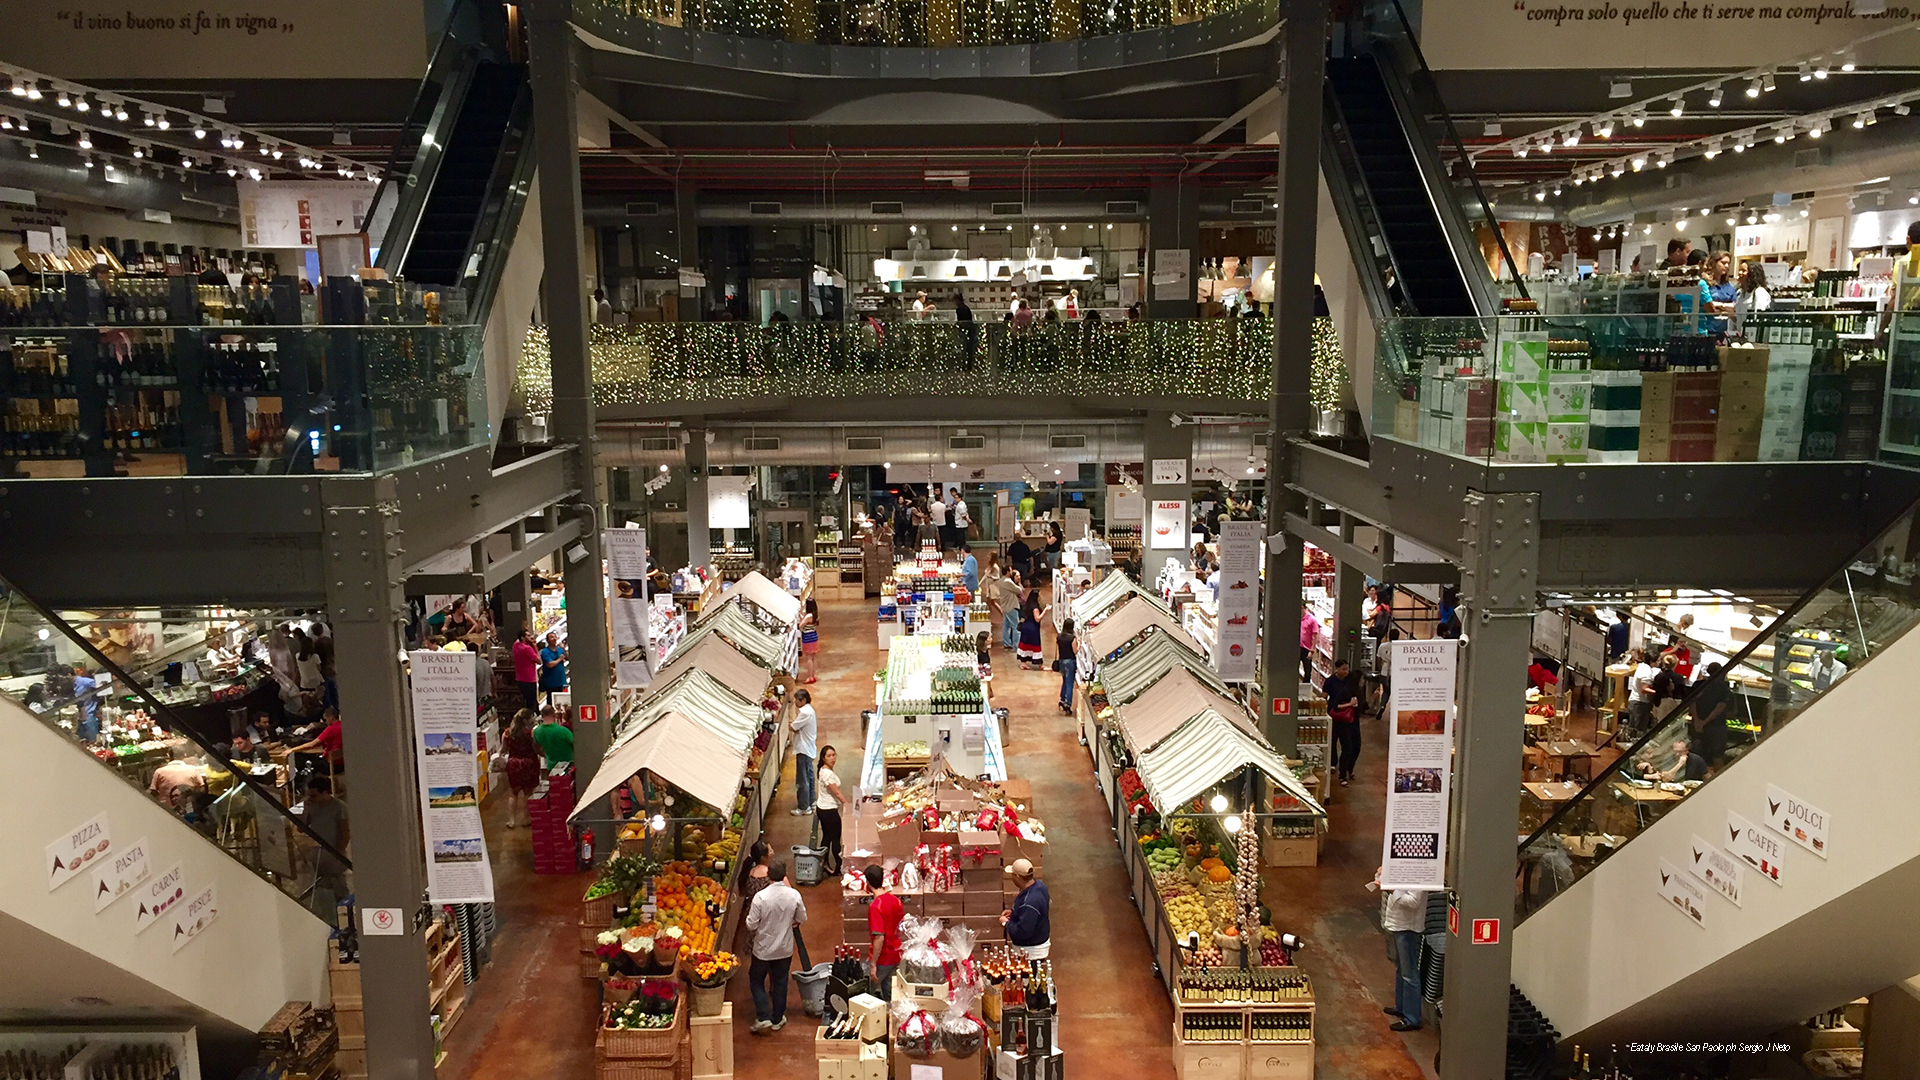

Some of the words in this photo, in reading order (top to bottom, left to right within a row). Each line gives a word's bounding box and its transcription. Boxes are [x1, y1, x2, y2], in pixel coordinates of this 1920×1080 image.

[88, 14, 122, 30] vino
[126, 11, 175, 30] buono
[179, 13, 191, 30] si
[192, 10, 211, 35] fa
[216, 13, 231, 30] in
[1587, 2, 1618, 20] solo
[1622, 1, 1669, 26] quello
[1673, 1, 1698, 20] che
[1702, 3, 1714, 20] ti
[1716, 6, 1755, 20] serve
[1759, 6, 1782, 20] ma
[420, 654, 456, 663] BRASIL
[458, 655, 465, 663] E
[1402, 645, 1438, 654] BRASIL
[1439, 645, 1446, 653] E
[1407, 656, 1441, 665] ITALIA
[427, 666, 460, 674] ITALIA
[415, 686, 475, 694] MONUMENTOS
[1787, 798, 1823, 831] DOLCI
[72, 822, 103, 850] PIZZA
[115, 846, 145, 874] PASTA
[151, 866, 181, 897] CARNE
[188, 888, 213, 918] PESCE
